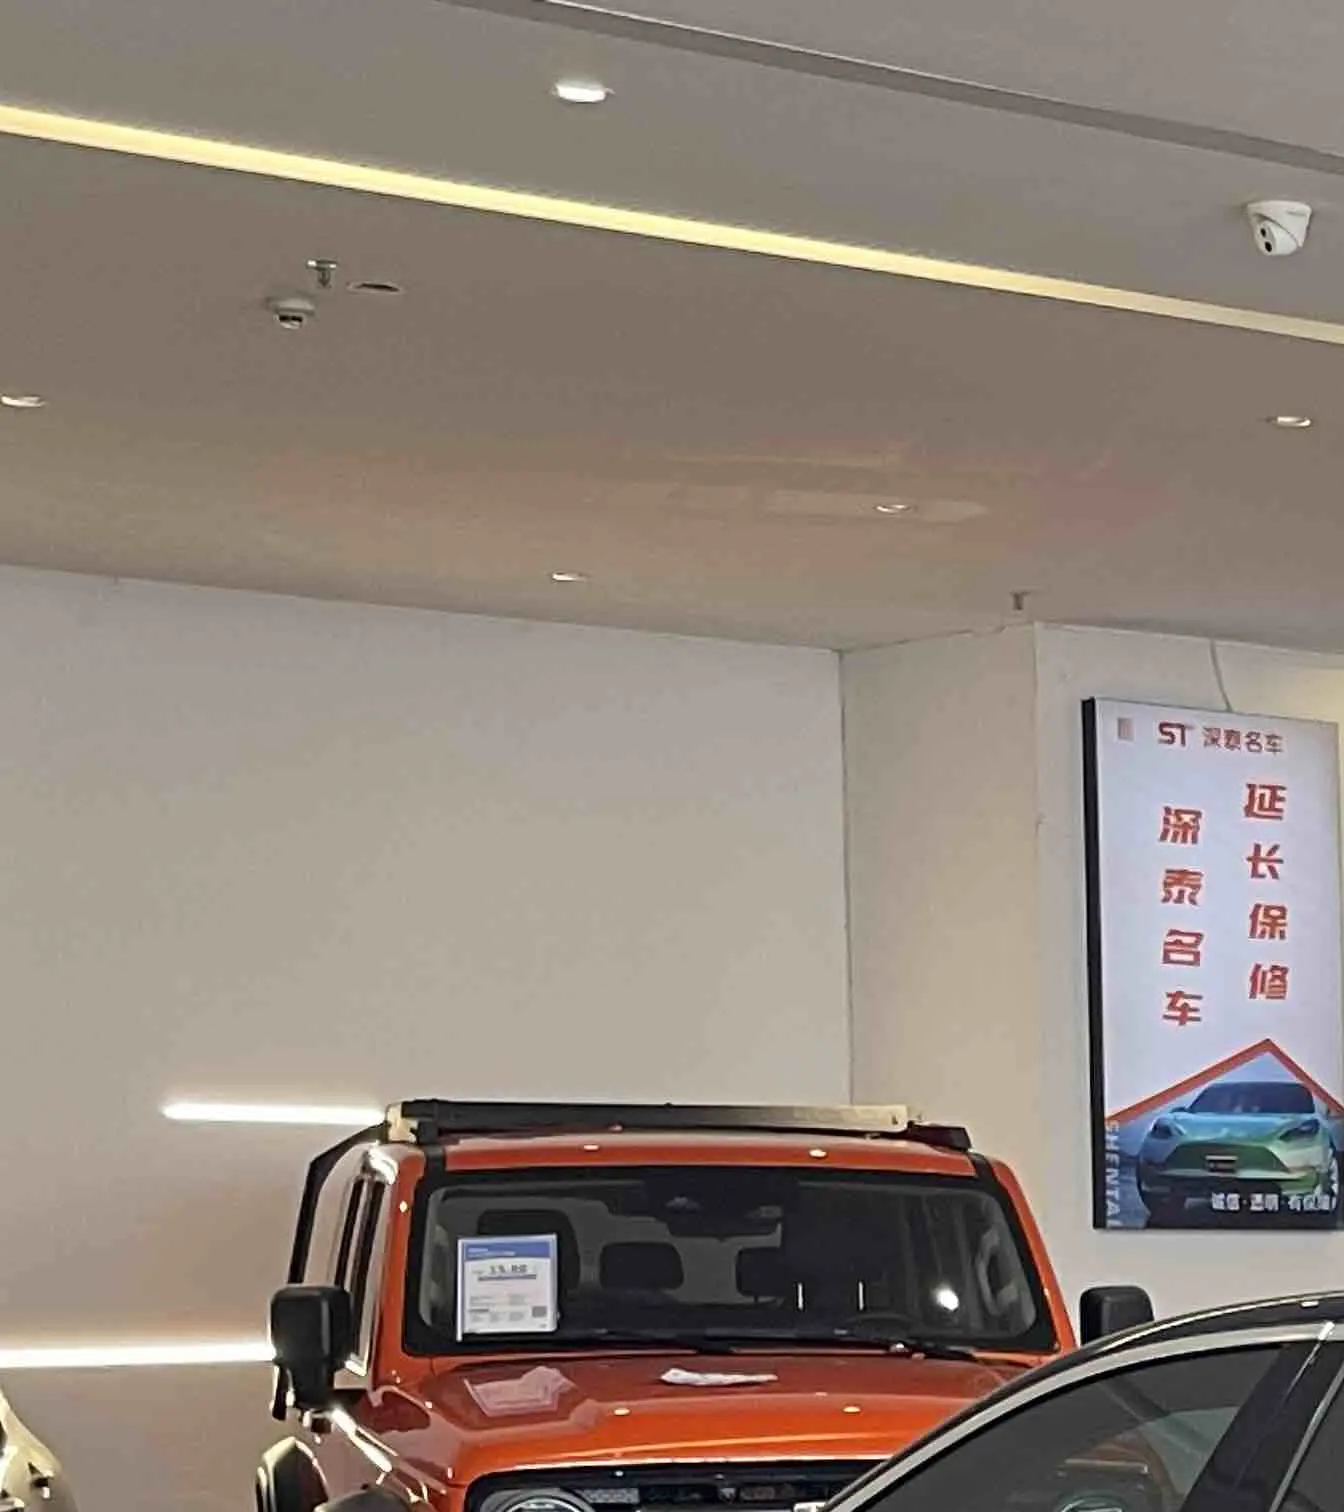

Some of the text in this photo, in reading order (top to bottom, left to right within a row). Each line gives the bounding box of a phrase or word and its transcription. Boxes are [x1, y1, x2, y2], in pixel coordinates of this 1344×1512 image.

[1159, 806, 1203, 1027] 深泰名车
[1244, 783, 1289, 1000] 延长保修
